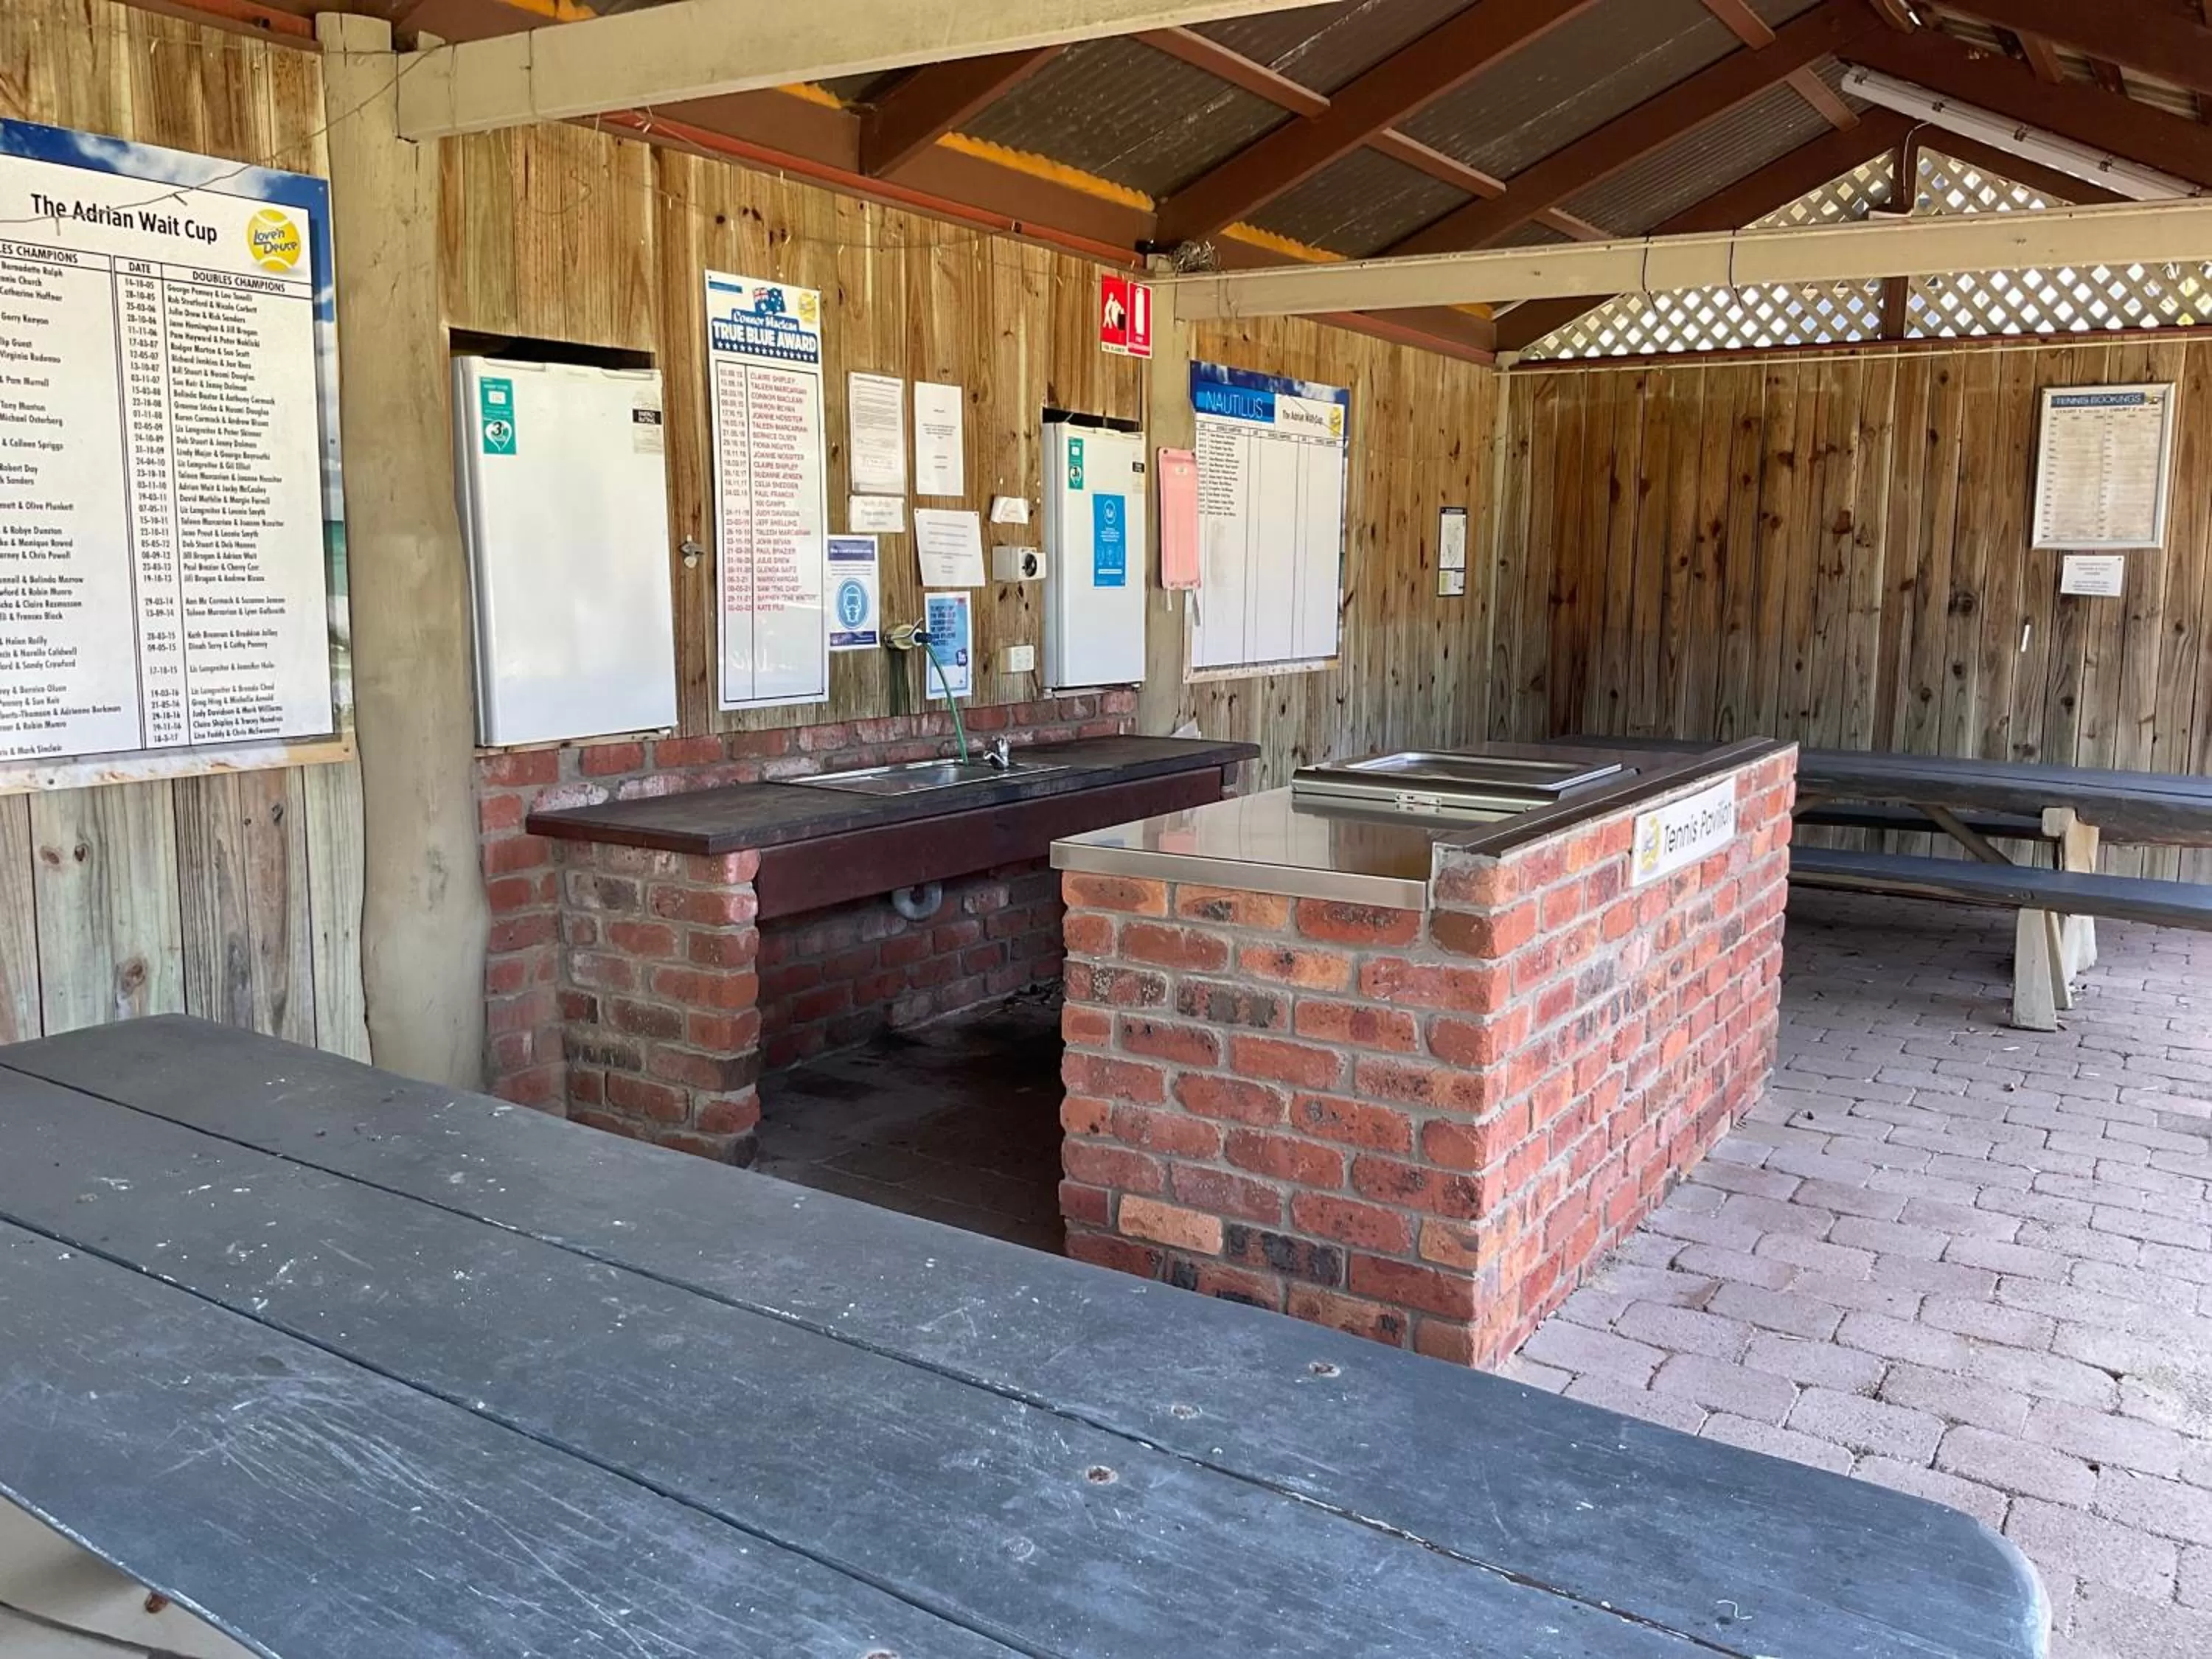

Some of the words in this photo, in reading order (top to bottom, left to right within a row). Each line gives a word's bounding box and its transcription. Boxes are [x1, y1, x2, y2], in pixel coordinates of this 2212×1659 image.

[30, 192, 66, 216] The
[73, 201, 134, 229] Adrian
[139, 211, 180, 236] Wait
[185, 220, 218, 245] Cup
[16, 246, 78, 264] CHAMPIONS
[128, 262, 151, 274] DATE
[192, 271, 232, 286] DOUBLES
[234, 277, 285, 293] CHAMPIONS
[734, 310, 764, 326] Connor
[713, 321, 745, 342] TRUE
[746, 326, 776, 347] BLUE
[776, 332, 816, 353] AWARD
[1206, 390, 1263, 419] NAUTILUS
[2090, 394, 2141, 404] BOOKINGS
[1663, 814, 1697, 855] Tennis
[1700, 801, 1732, 838] Pavilion
